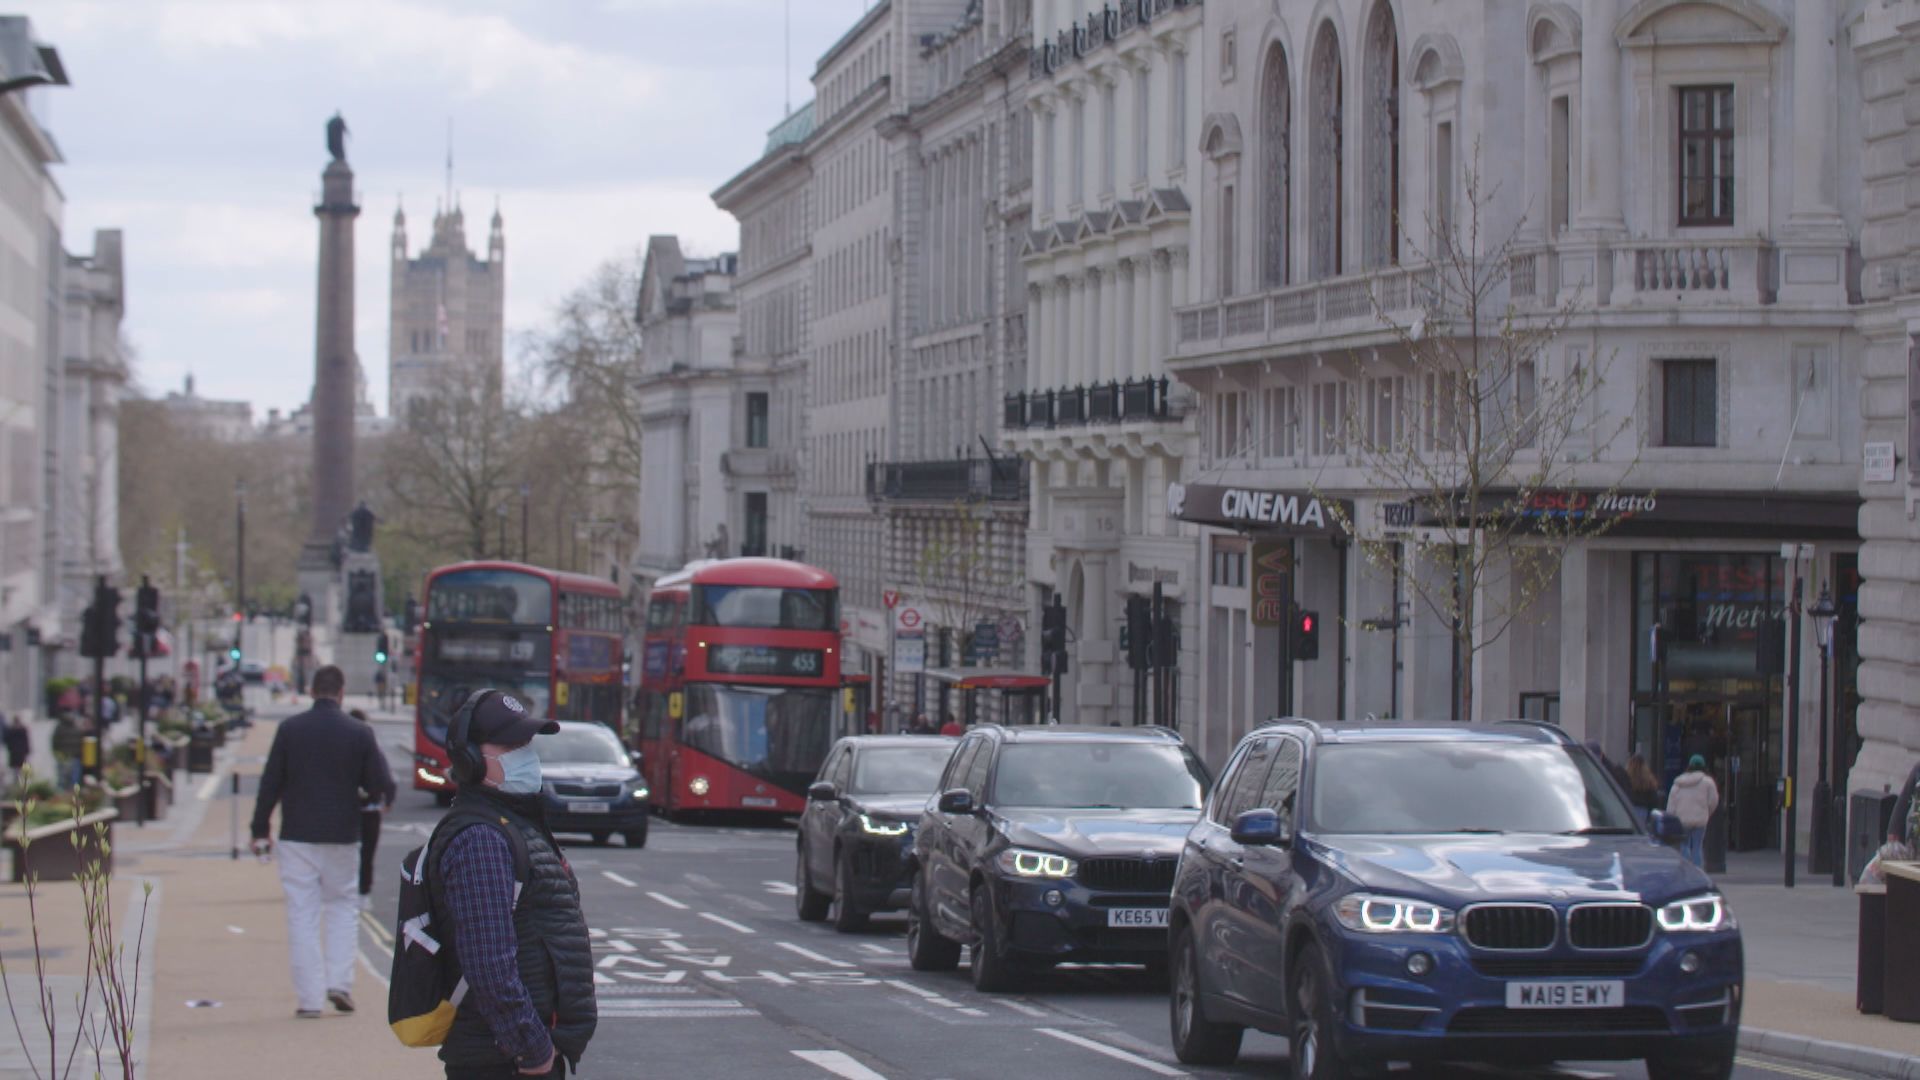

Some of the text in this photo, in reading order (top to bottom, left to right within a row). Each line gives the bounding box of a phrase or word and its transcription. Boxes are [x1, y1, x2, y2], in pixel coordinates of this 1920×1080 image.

[1222, 489, 1324, 528] CINEMA
[1596, 493, 1657, 511] Metro
[1114, 910, 1153, 924] KE65
[1520, 984, 1612, 1004] WA19 EWY
